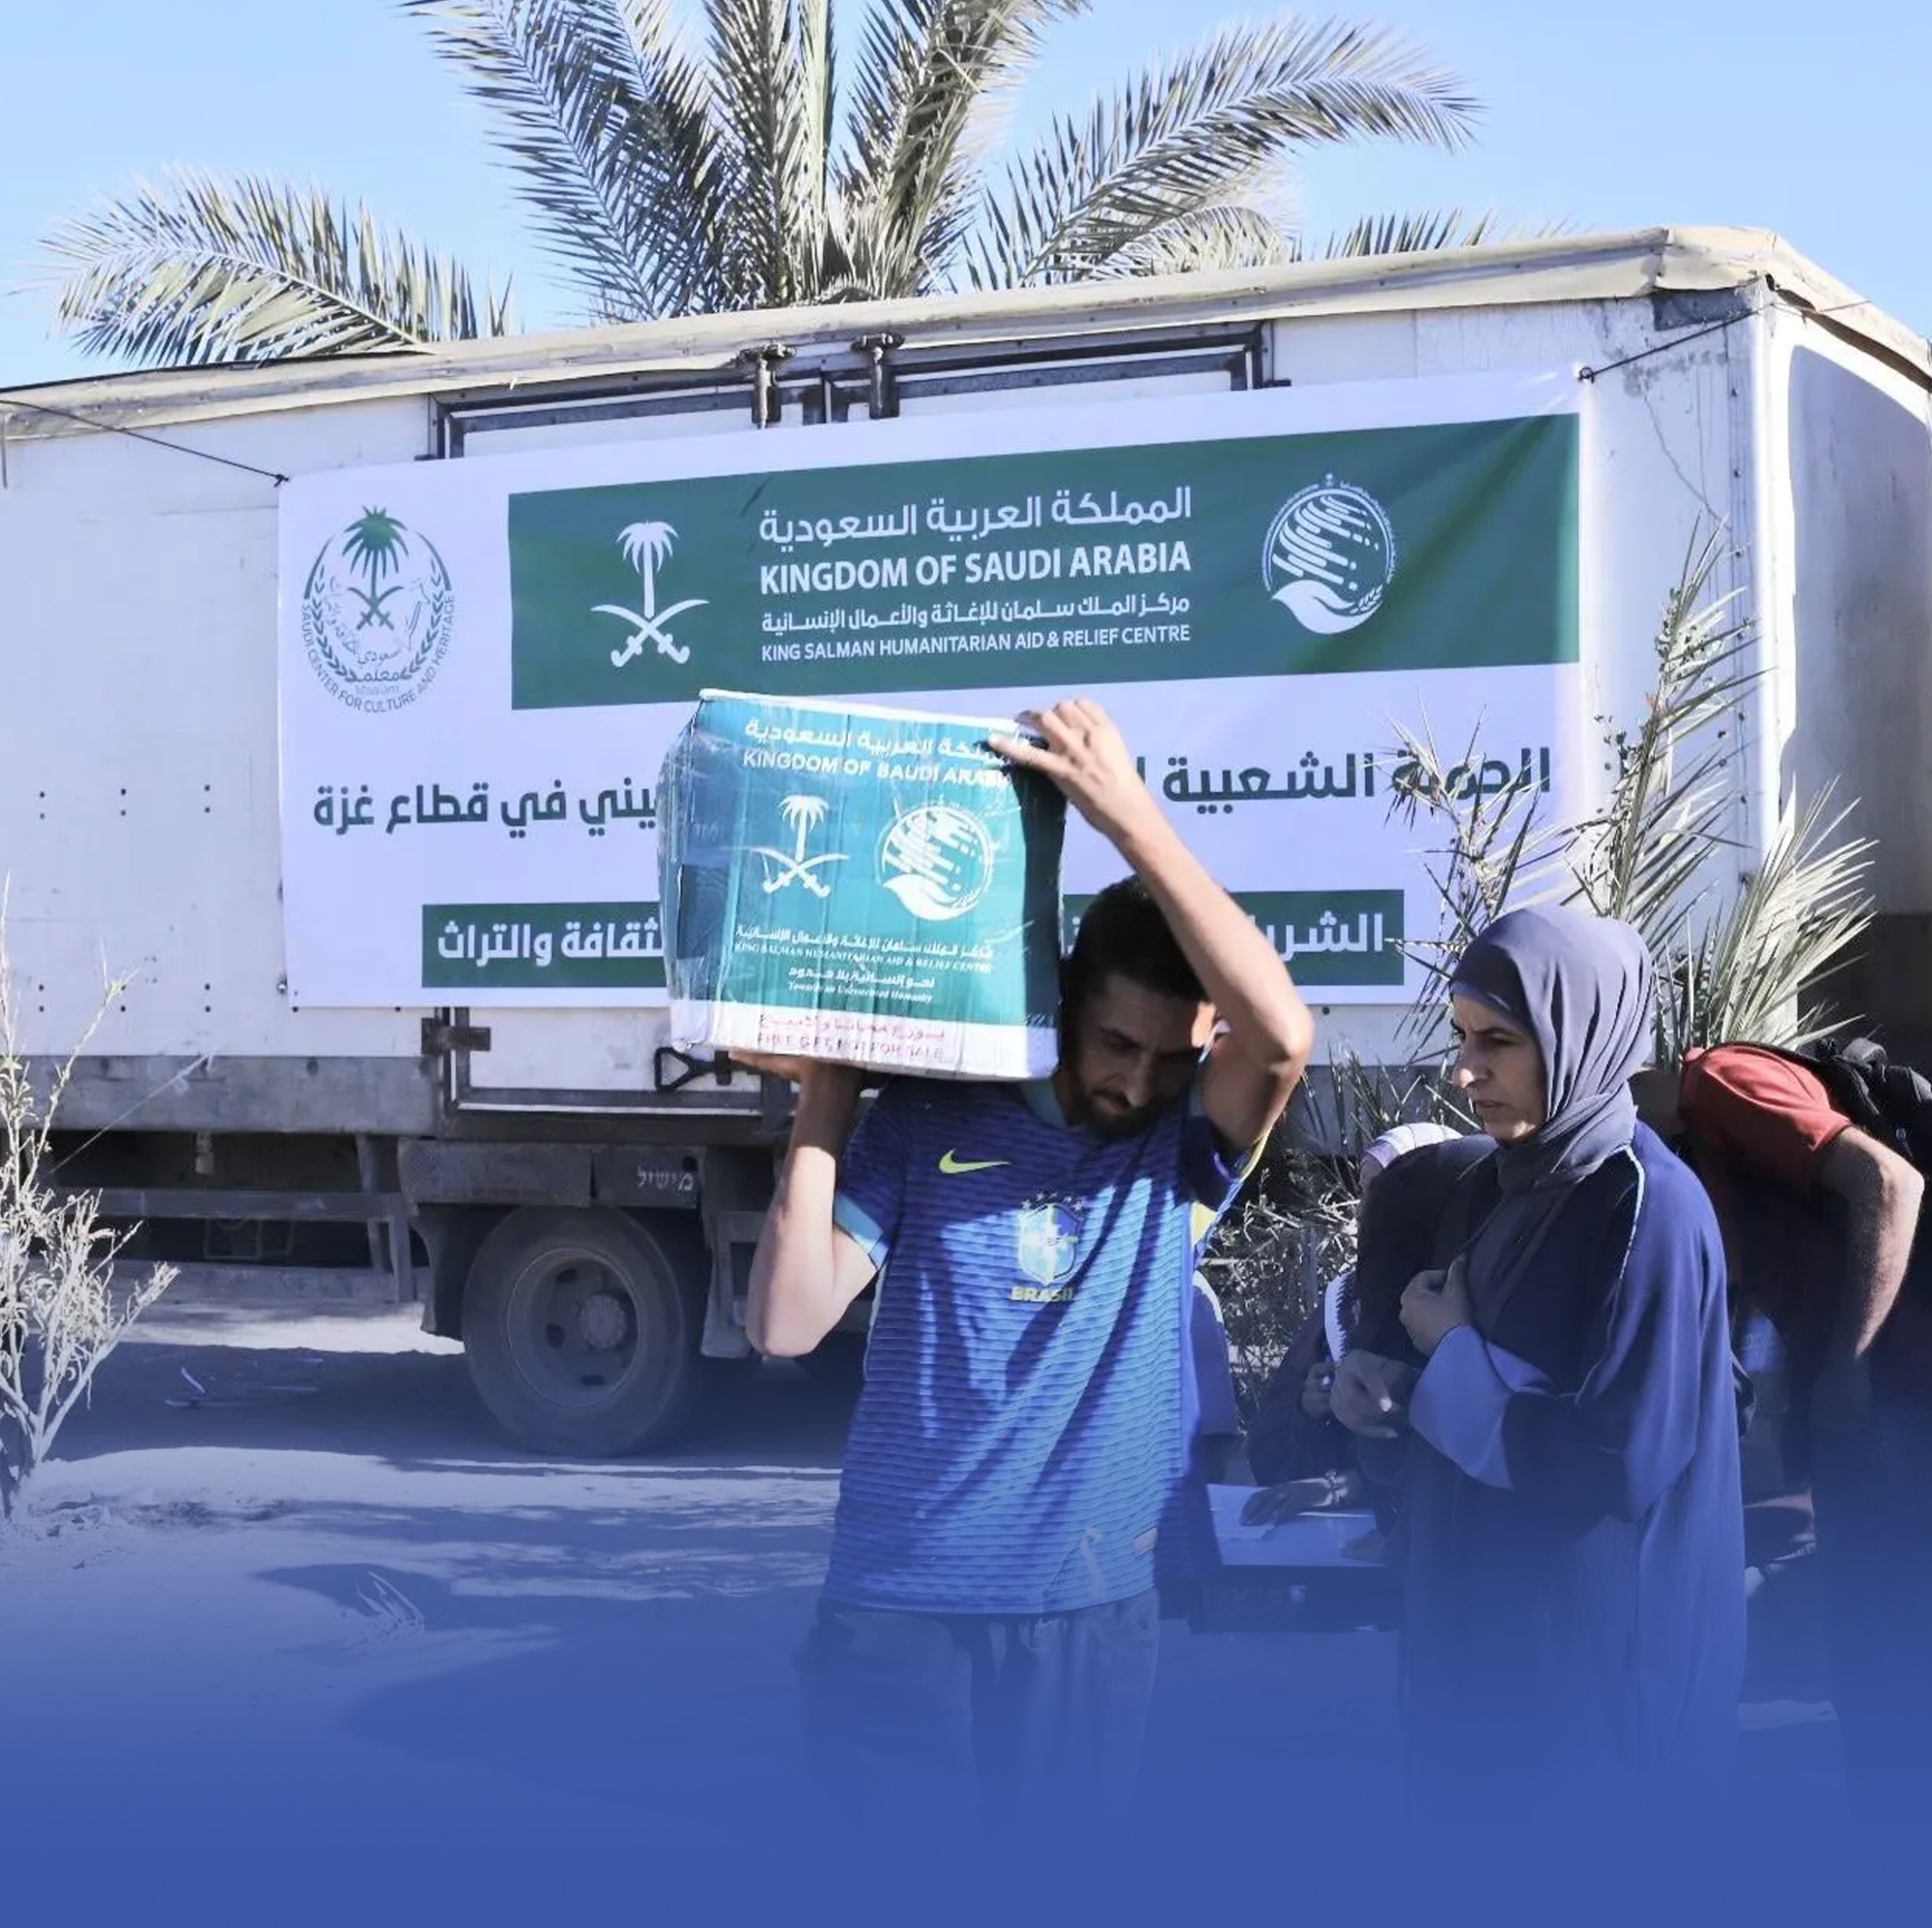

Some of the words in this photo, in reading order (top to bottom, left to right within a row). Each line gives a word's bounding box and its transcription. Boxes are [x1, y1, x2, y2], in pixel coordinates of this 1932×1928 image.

[925, 496, 1041, 542] العربية
[1051, 486, 1191, 525] المملكة
[759, 504, 917, 553] السعودية
[760, 557, 909, 595] KINGDOM
[915, 554, 956, 585] OF
[965, 549, 1061, 583] SAUDI
[1069, 541, 1192, 578] ARABIA
[761, 609, 845, 636] الإنسانية
[848, 603, 928, 630] والأعمال
[931, 600, 997, 625] للإغاثة
[1001, 599, 1075, 622] سلمان
[1077, 594, 1137, 616] الملك
[1138, 592, 1190, 617] مركز
[300, 604, 315, 647] SAUDI
[308, 649, 339, 697] CENTER
[338, 690, 362, 711] FOR
[363, 689, 417, 713] CULTURE
[417, 666, 437, 694] AND
[434, 595, 456, 666] HERITAGE
[761, 644, 801, 662] KING
[804, 639, 874, 660] SALMAN
[879, 634, 1011, 656] HUMANITARIAN
[1014, 632, 1044, 649] AID
[1046, 631, 1059, 647] &
[1063, 628, 1119, 647] RELIEF
[1122, 624, 1191, 644] CENTRE
[742, 748, 838, 774] KINGDOM
[842, 758, 871, 777] OF
[877, 762, 939, 781] SAUDI
[1163, 751, 1374, 814] الشعبية
[314, 784, 374, 836] غزة
[385, 782, 488, 834] قطاع
[500, 780, 566, 838] في
[438, 920, 553, 967] والتراث
